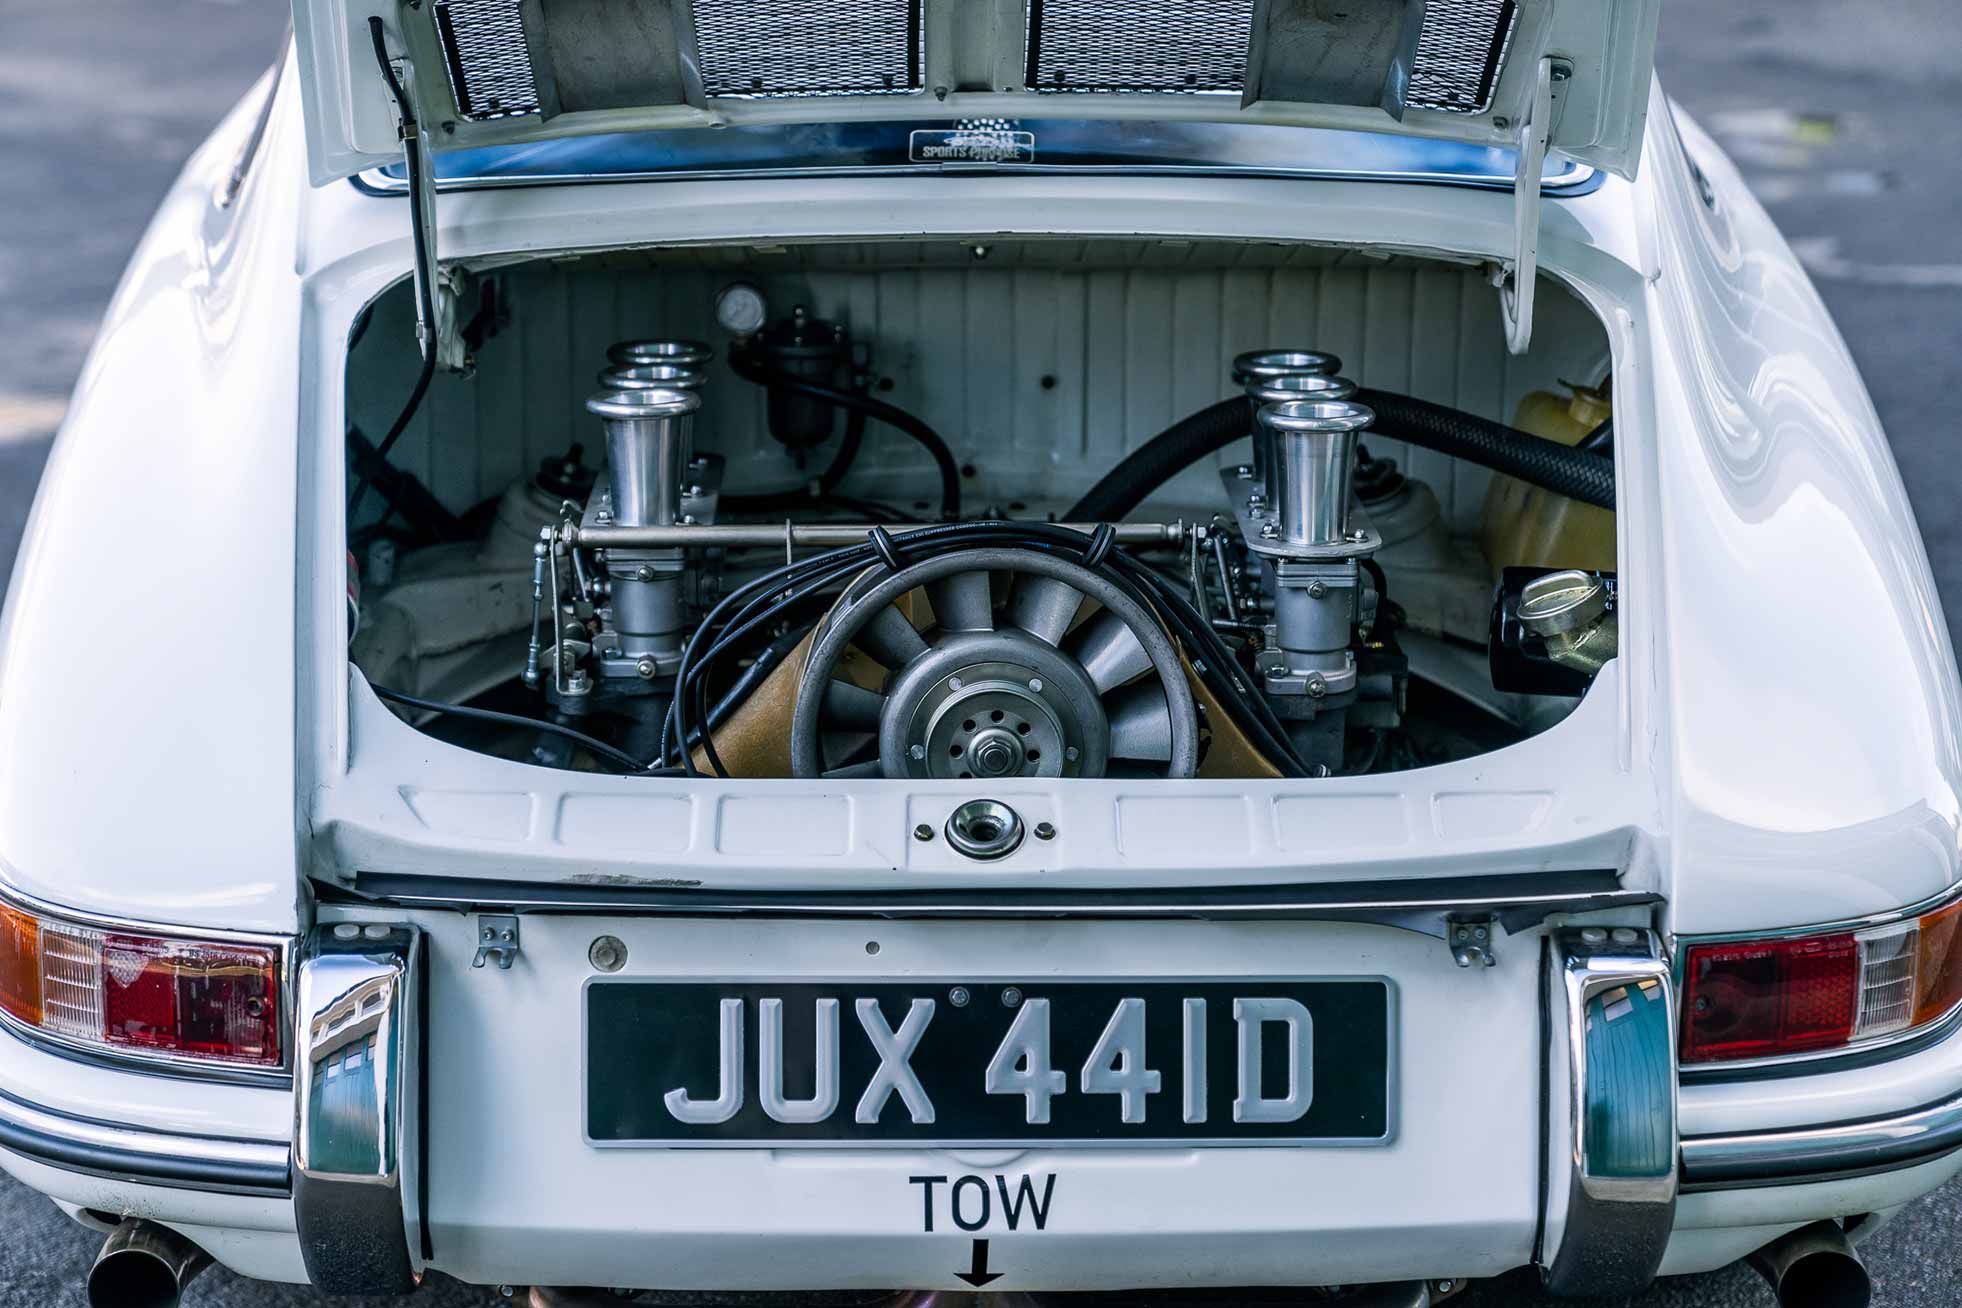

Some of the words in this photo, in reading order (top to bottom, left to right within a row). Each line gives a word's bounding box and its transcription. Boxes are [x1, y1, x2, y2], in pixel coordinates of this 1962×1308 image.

[922, 145, 967, 158] SPORTS
[664, 998, 936, 1124] JUX
[985, 998, 1314, 1124] 441D
[909, 1173, 1057, 1232] TOW
